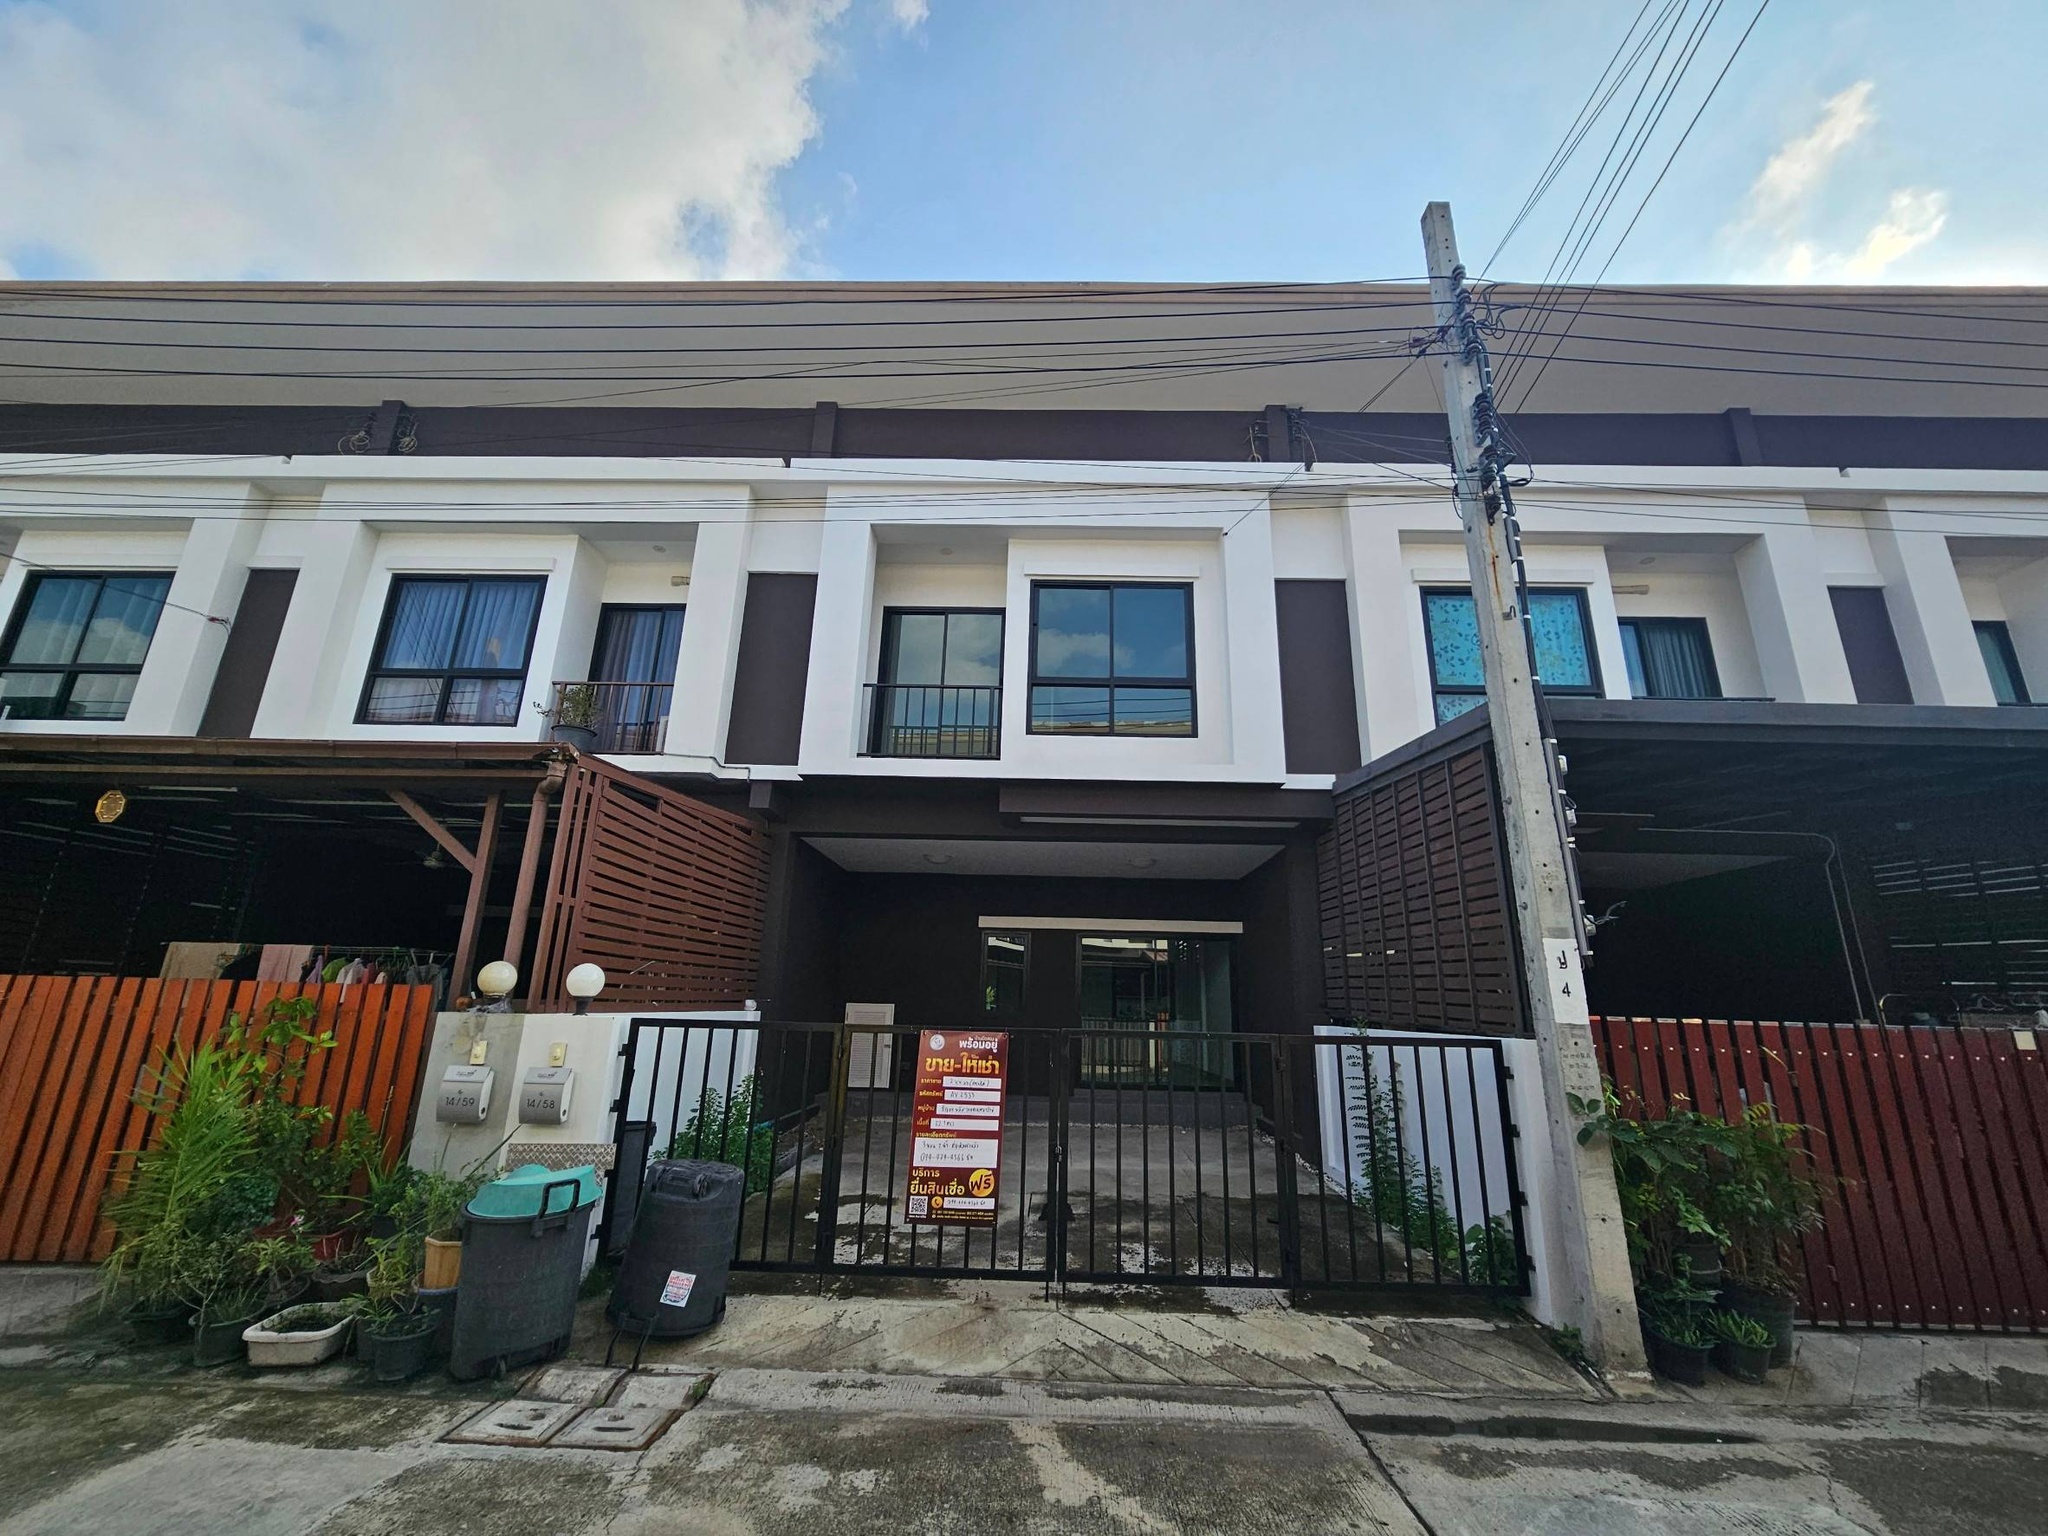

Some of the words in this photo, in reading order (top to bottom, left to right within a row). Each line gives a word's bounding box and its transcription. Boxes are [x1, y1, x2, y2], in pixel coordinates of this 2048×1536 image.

[1562, 981, 1572, 997] 4
[959, 1037, 998, 1053] พร้อมอยู่
[925, 1052, 1000, 1074] ขาย-ให้เช่า
[445, 1096, 475, 1107] 14/59
[526, 1098, 555, 1109] 14/58
[912, 1167, 940, 1178] บริการ
[910, 1177, 965, 1196] ยื่นสินเชื่อ
[970, 1170, 993, 1192] ฟรี
